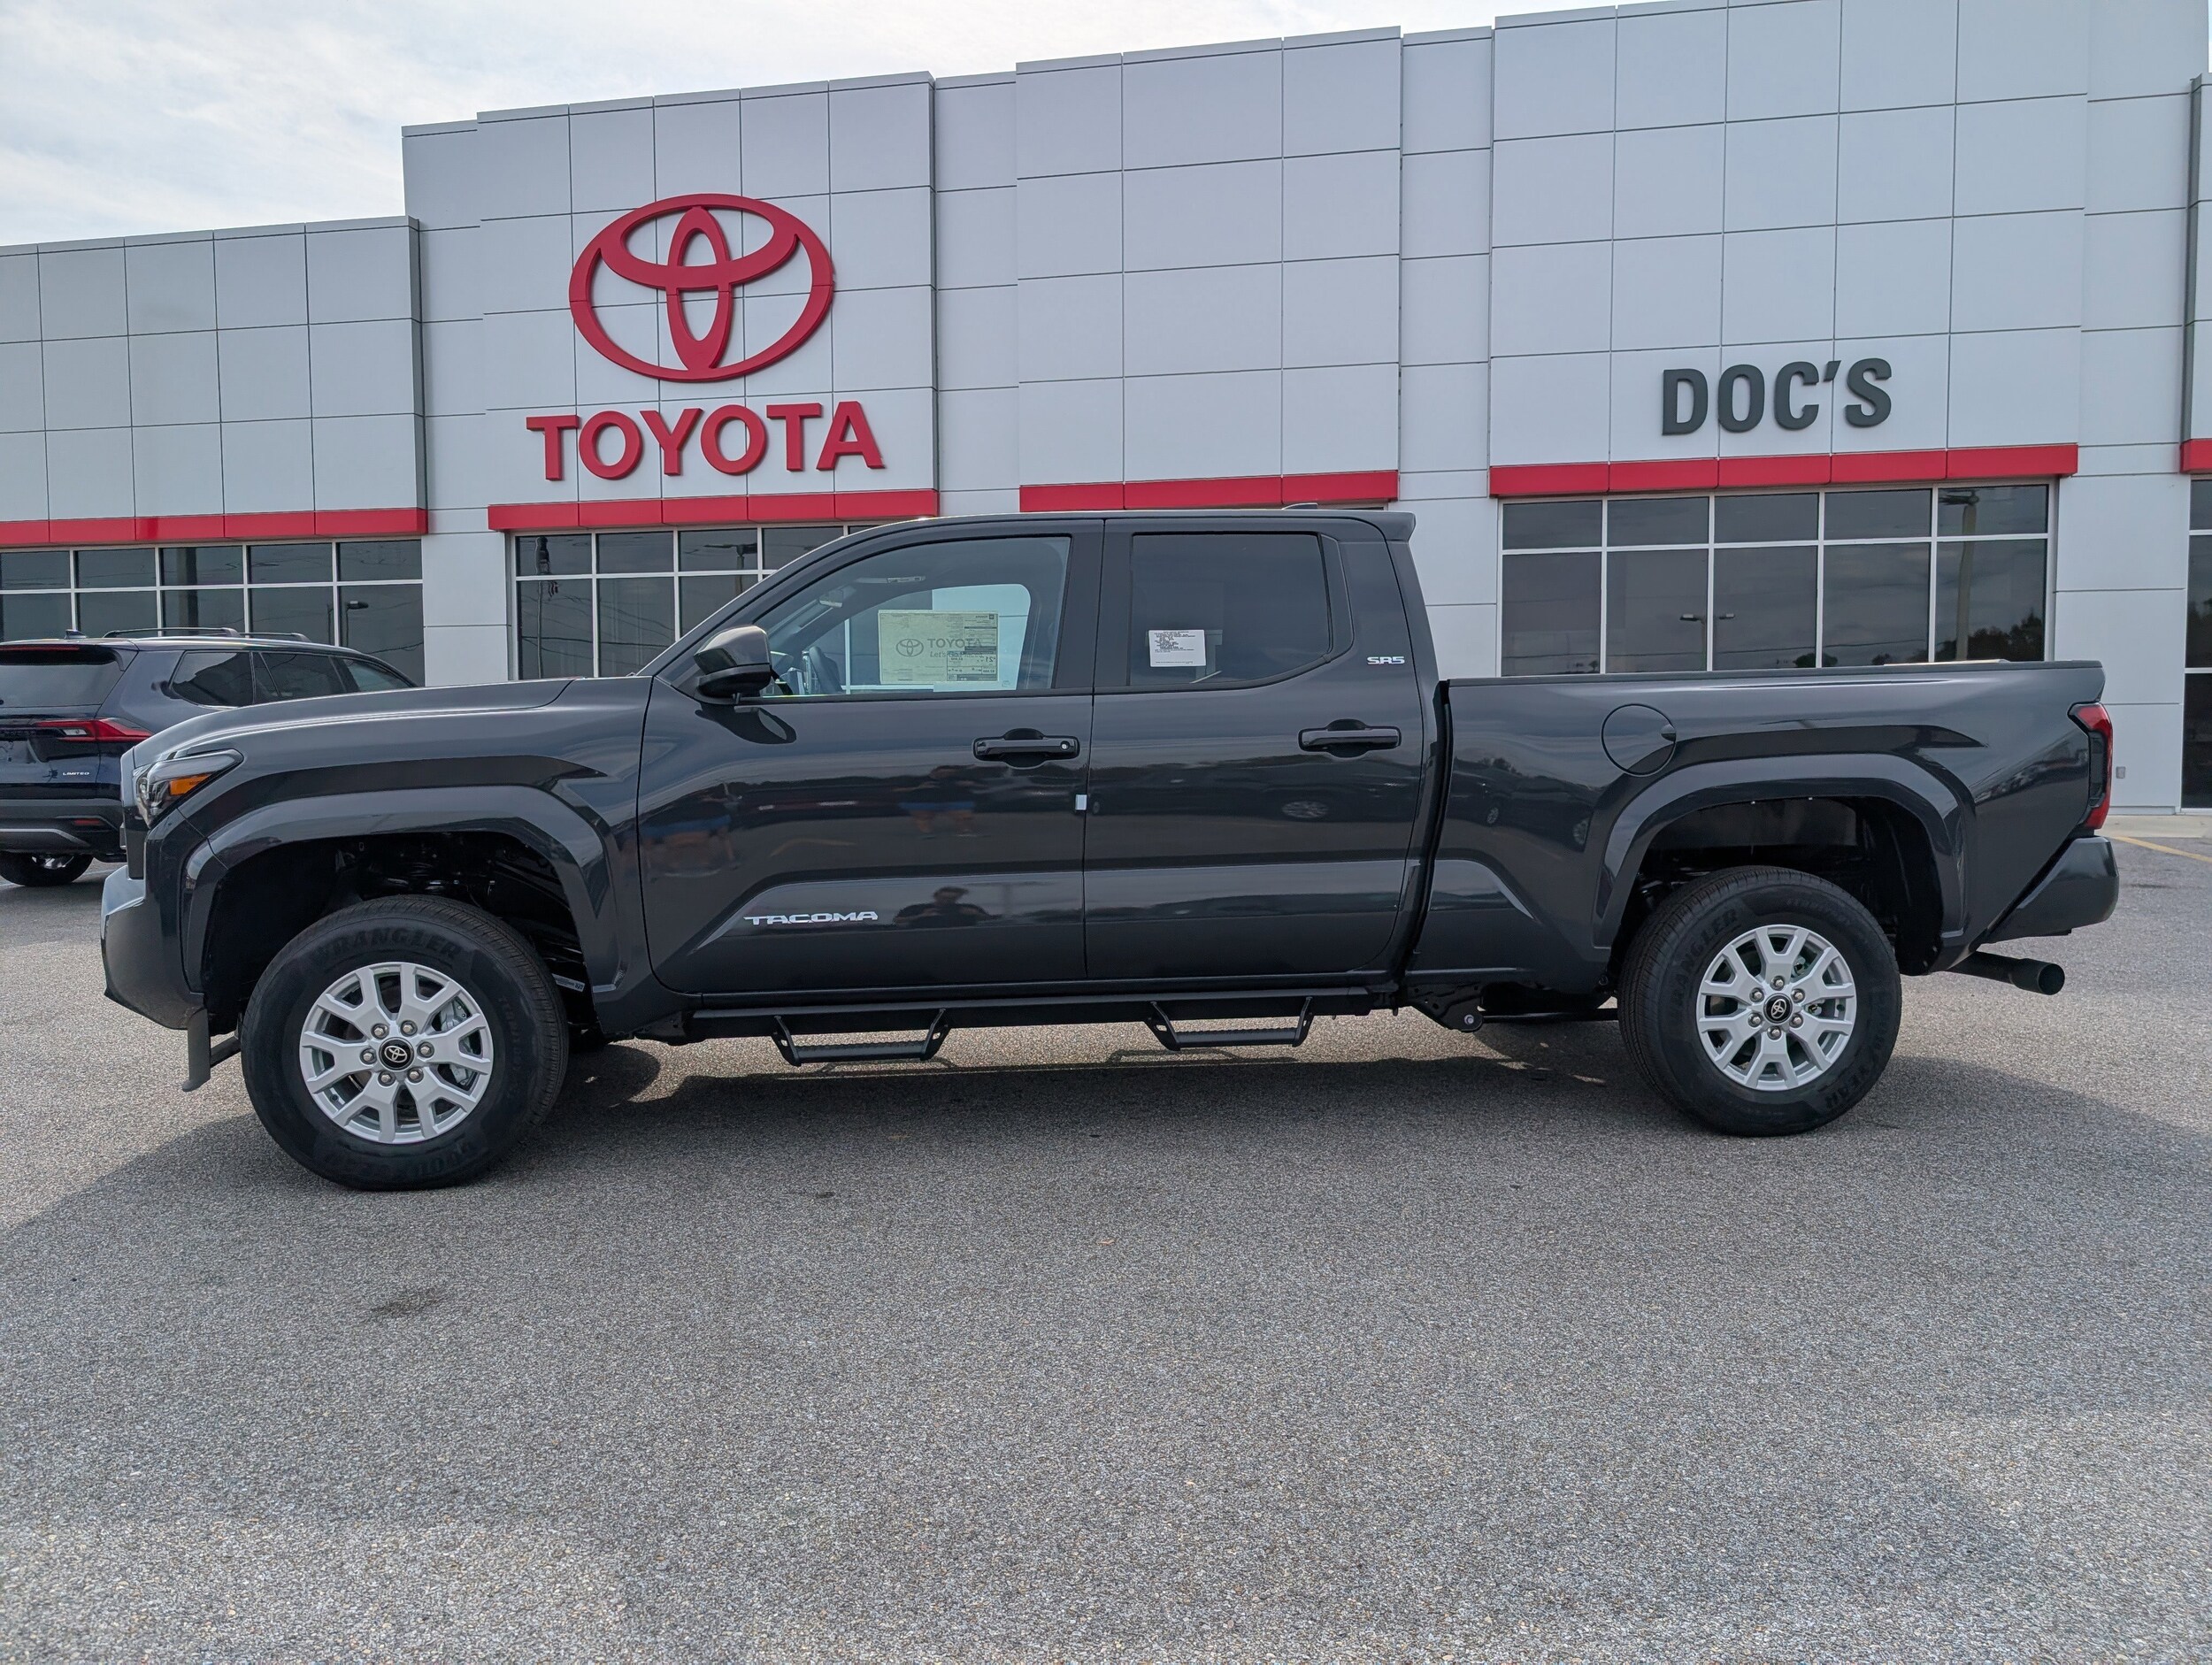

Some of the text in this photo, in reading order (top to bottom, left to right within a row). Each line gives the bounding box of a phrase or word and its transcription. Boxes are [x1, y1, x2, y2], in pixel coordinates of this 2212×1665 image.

[1662, 357, 1893, 435] DOC'S
[526, 401, 886, 481] TOYOTA
[1367, 656, 1405, 664] SR5
[743, 911, 879, 925] TACOMA
